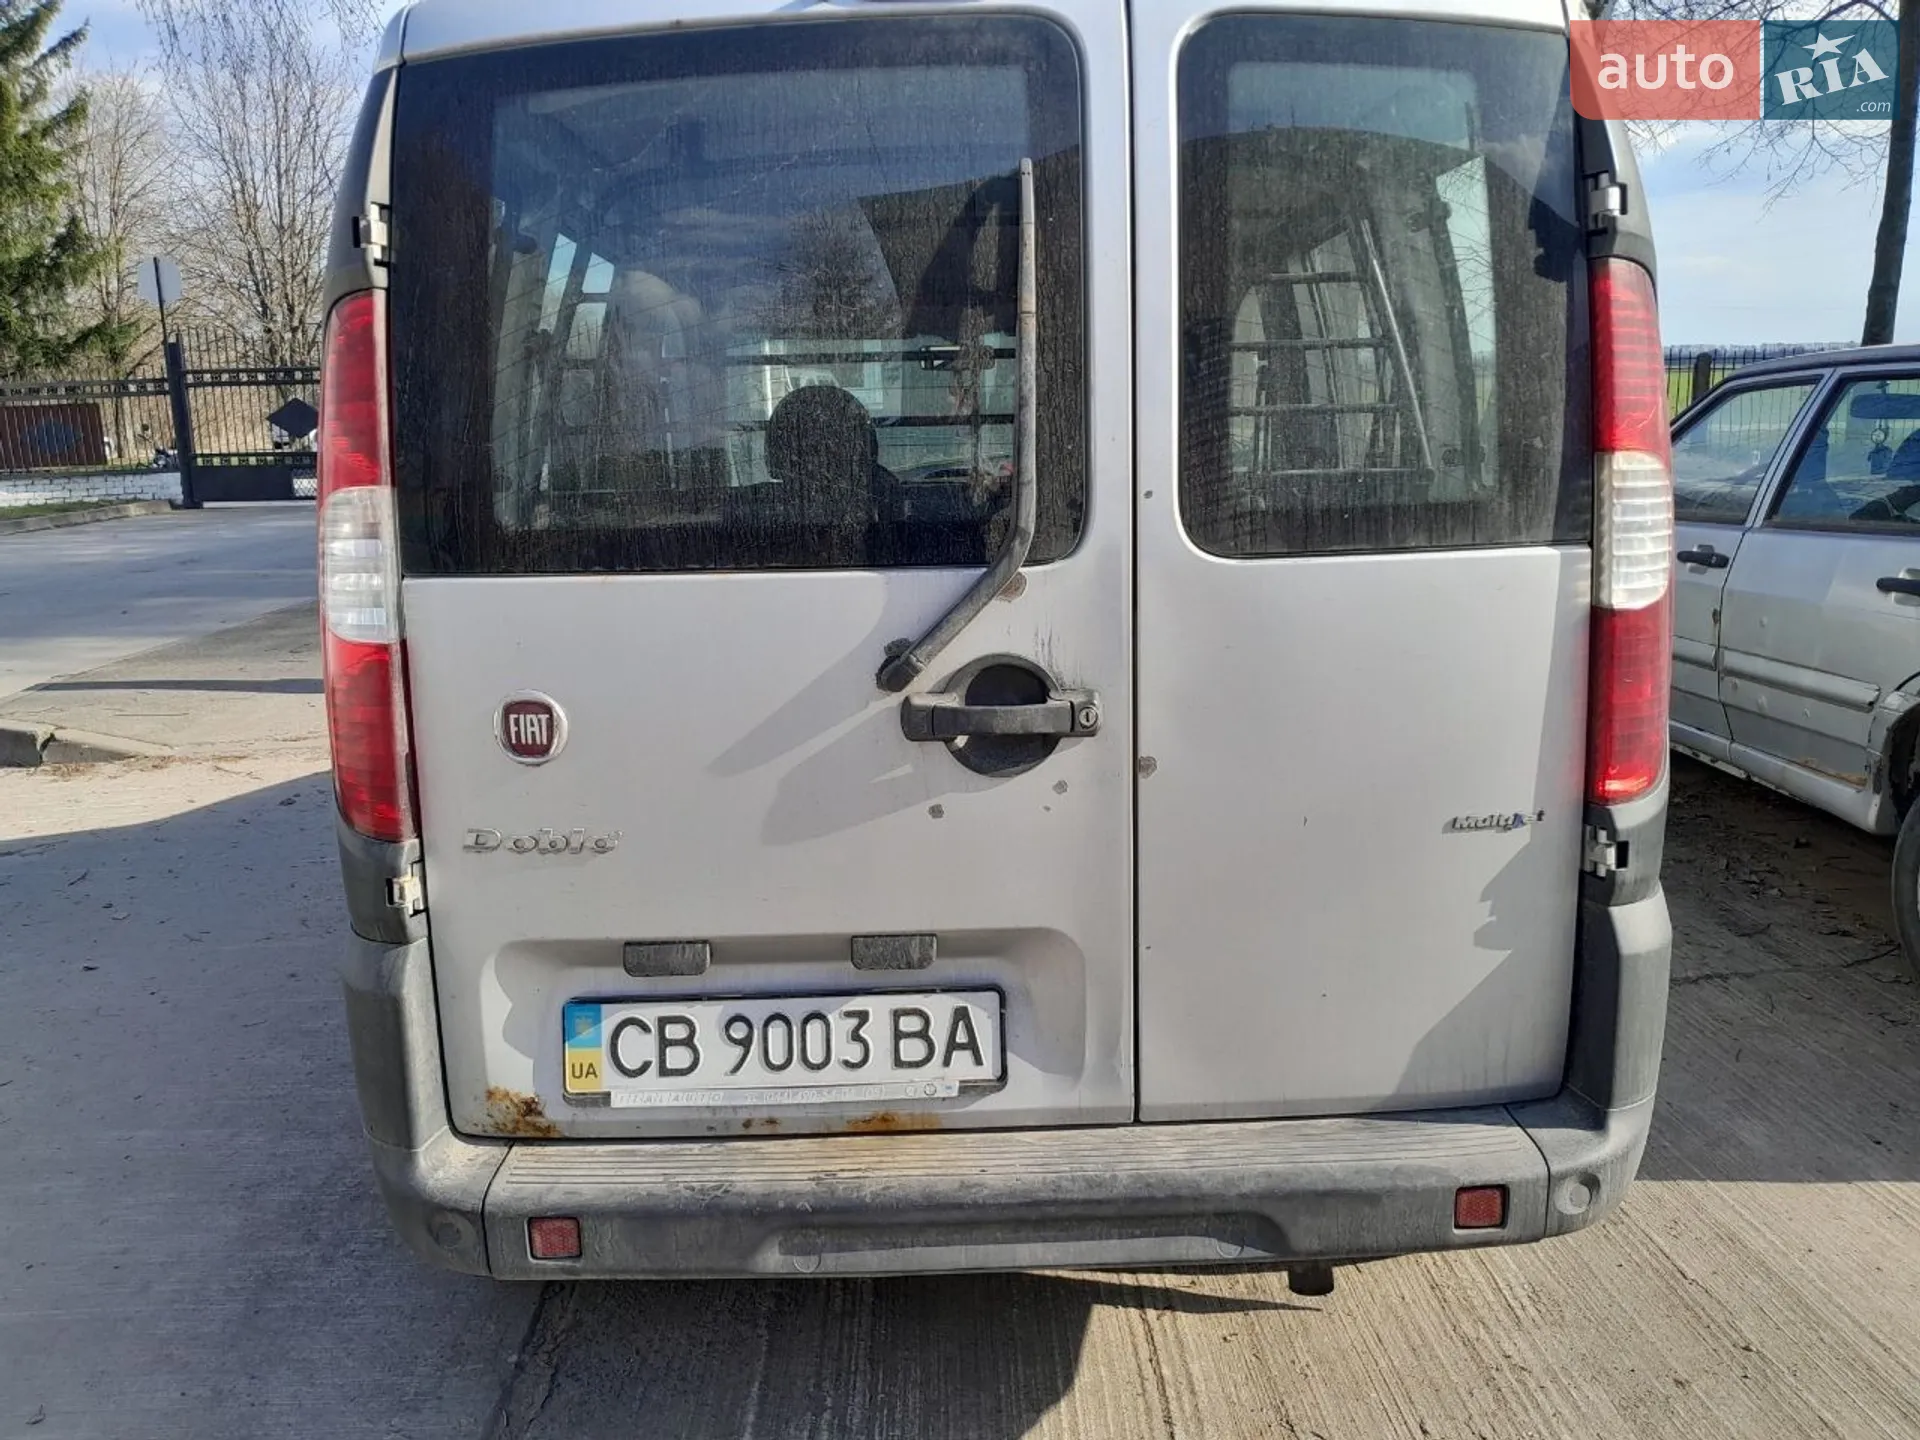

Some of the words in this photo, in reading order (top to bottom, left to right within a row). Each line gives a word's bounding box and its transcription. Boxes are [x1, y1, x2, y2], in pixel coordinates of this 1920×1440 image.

[508, 714, 550, 745] FIAT
[609, 1014, 701, 1078] CB
[724, 1008, 871, 1076] 9003
[891, 1005, 985, 1069] BA
[571, 1064, 598, 1080] UA
